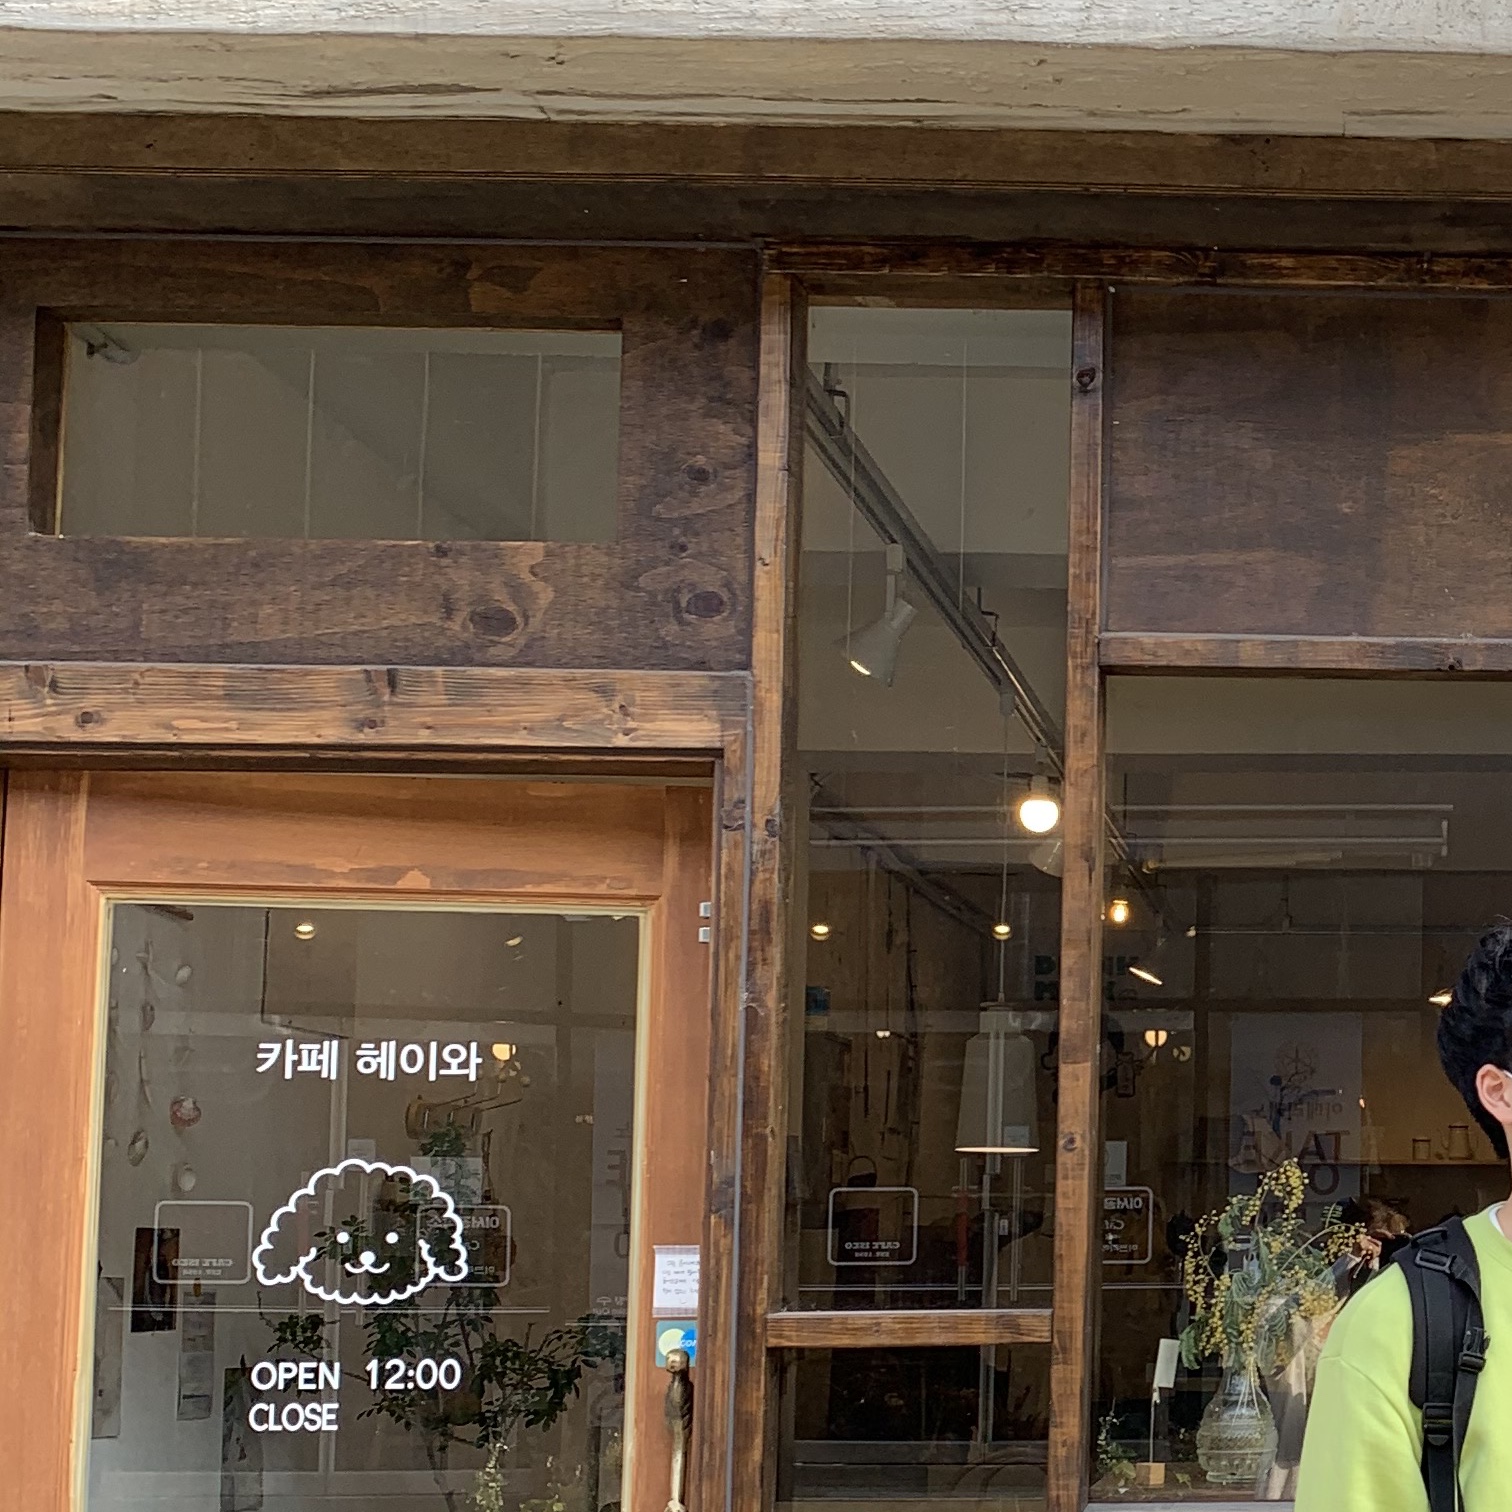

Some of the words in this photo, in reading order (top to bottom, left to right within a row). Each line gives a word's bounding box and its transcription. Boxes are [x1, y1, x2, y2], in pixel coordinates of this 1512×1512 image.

[255, 1038, 340, 1081] 카페
[355, 1039, 483, 1082] 헤이와
[250, 1361, 341, 1390] OPEN
[365, 1358, 462, 1390] 12:00
[248, 1403, 339, 1432] CLOSE
